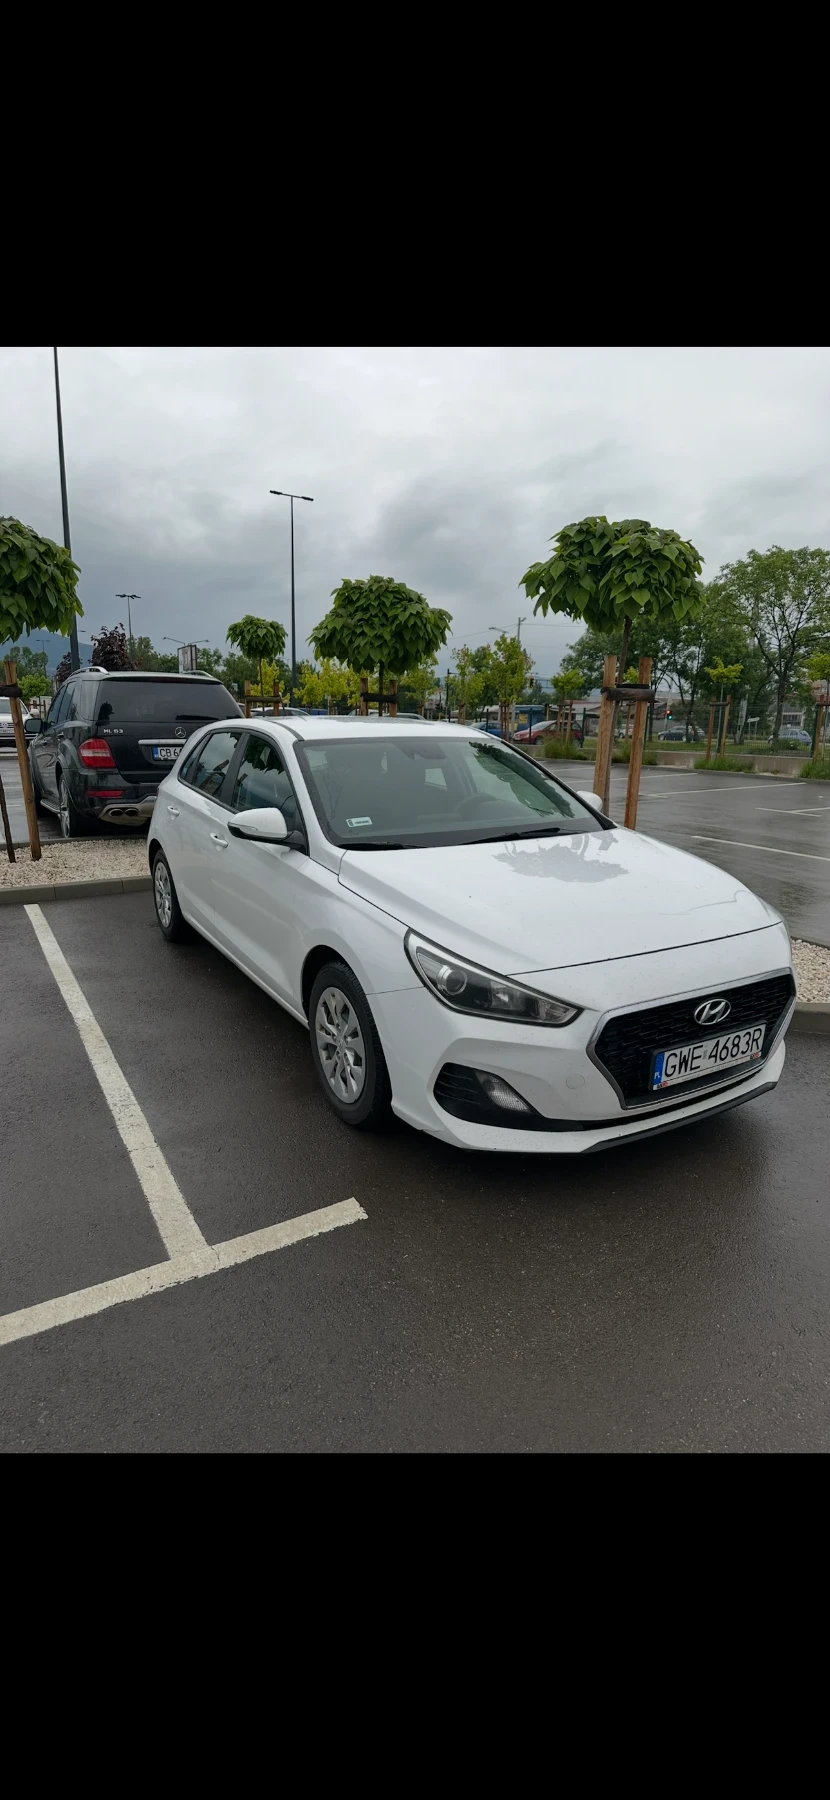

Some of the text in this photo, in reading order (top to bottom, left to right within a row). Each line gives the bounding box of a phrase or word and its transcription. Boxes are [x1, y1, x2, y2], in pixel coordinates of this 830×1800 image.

[159, 748, 172, 758] CB
[664, 1044, 704, 1077] GWE
[708, 1028, 762, 1063] 4683R
[653, 1071, 661, 1080] PL
